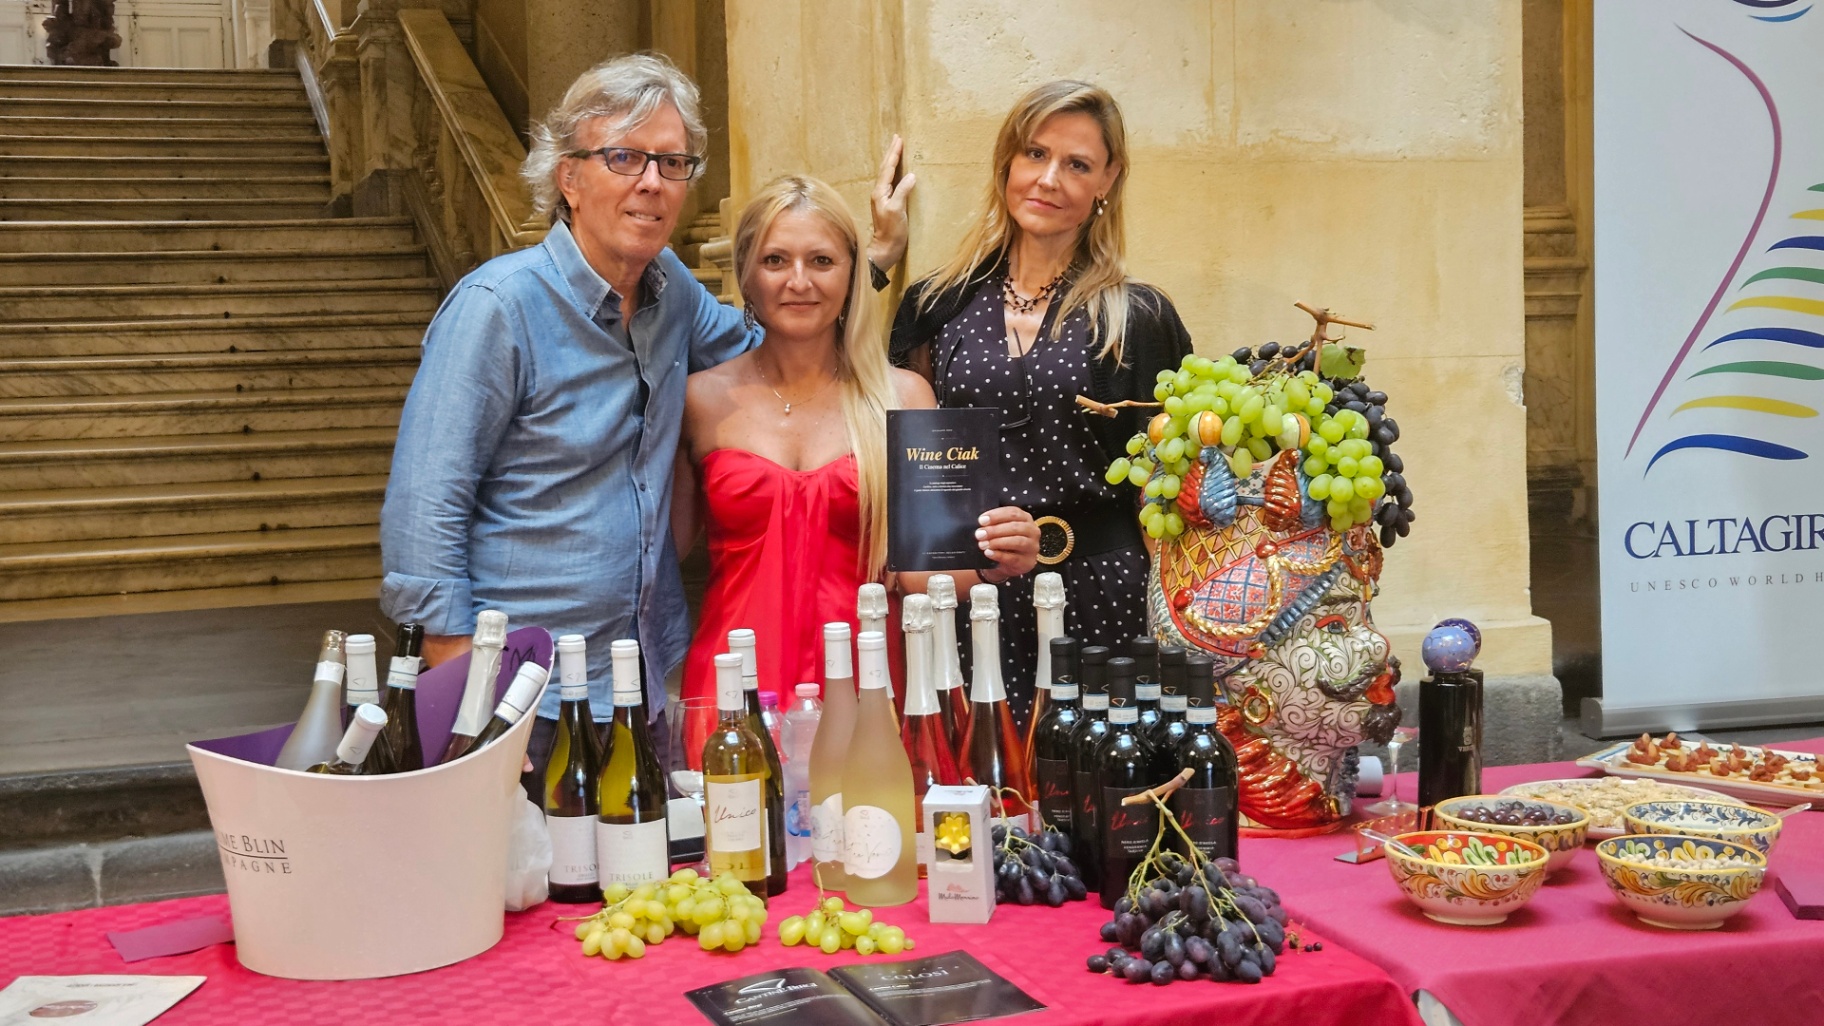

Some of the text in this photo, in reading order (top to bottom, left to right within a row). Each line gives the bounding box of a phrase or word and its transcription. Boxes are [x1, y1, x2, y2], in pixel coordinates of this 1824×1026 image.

[906, 447, 979, 461] Wine Ciak
[1624, 513, 1824, 560] CALTAGIR
[1630, 577, 1718, 593] UNESCO
[1729, 573, 1804, 587] WORLD
[714, 804, 758, 824] Unico
[241, 835, 286, 854] BLIN
[564, 863, 600, 874] TRISO
[609, 871, 654, 882] TRISOLE
